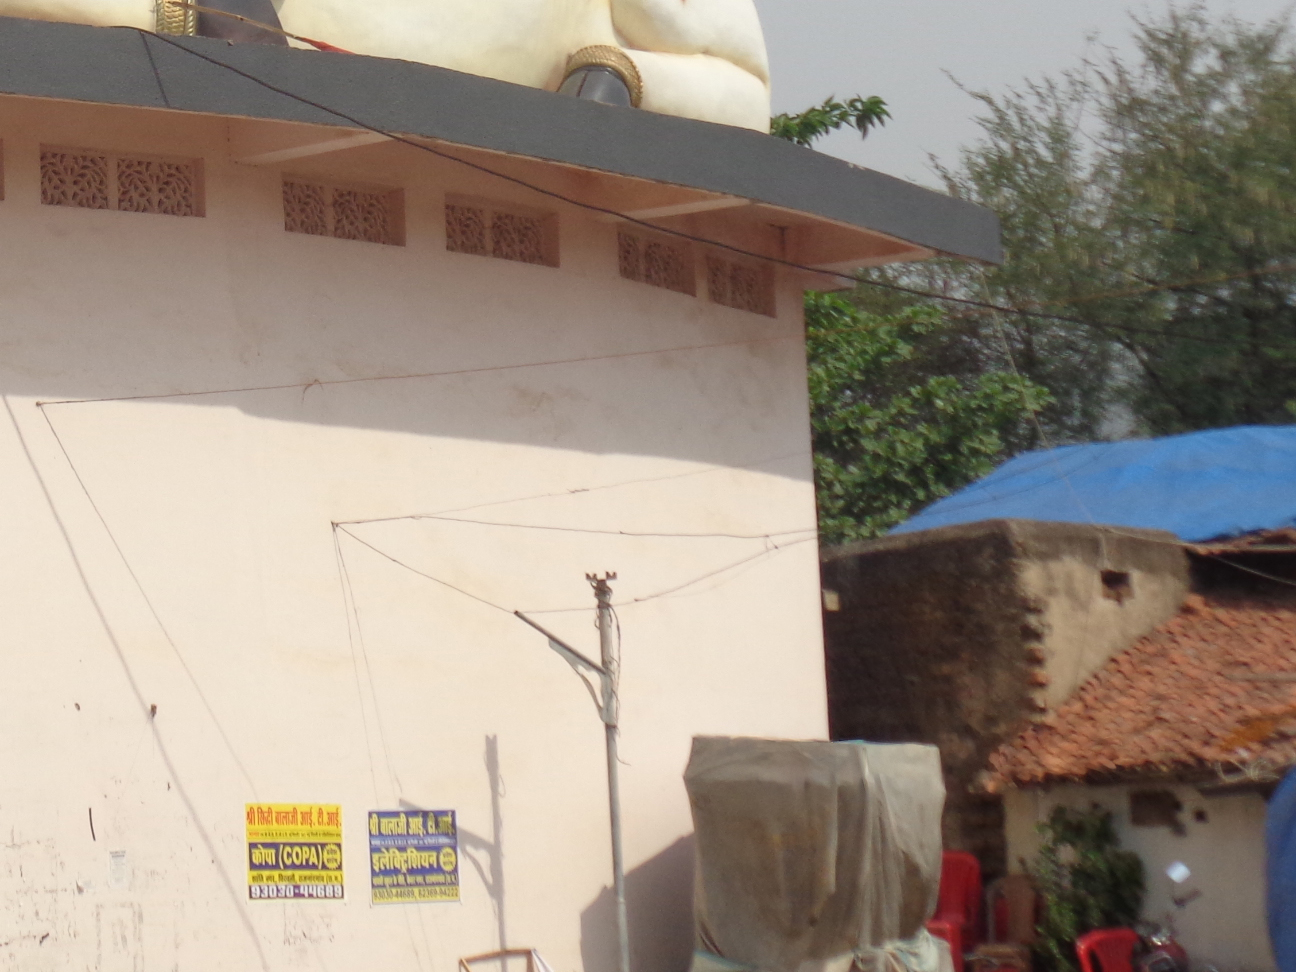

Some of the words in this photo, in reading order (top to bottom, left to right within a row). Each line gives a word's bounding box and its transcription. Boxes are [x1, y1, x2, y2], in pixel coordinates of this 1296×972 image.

[275, 807, 298, 826] बालाजी
[251, 844, 276, 866] कोपा
[279, 844, 322, 870] (COPA)
[251, 885, 342, 899] 93030-44689
